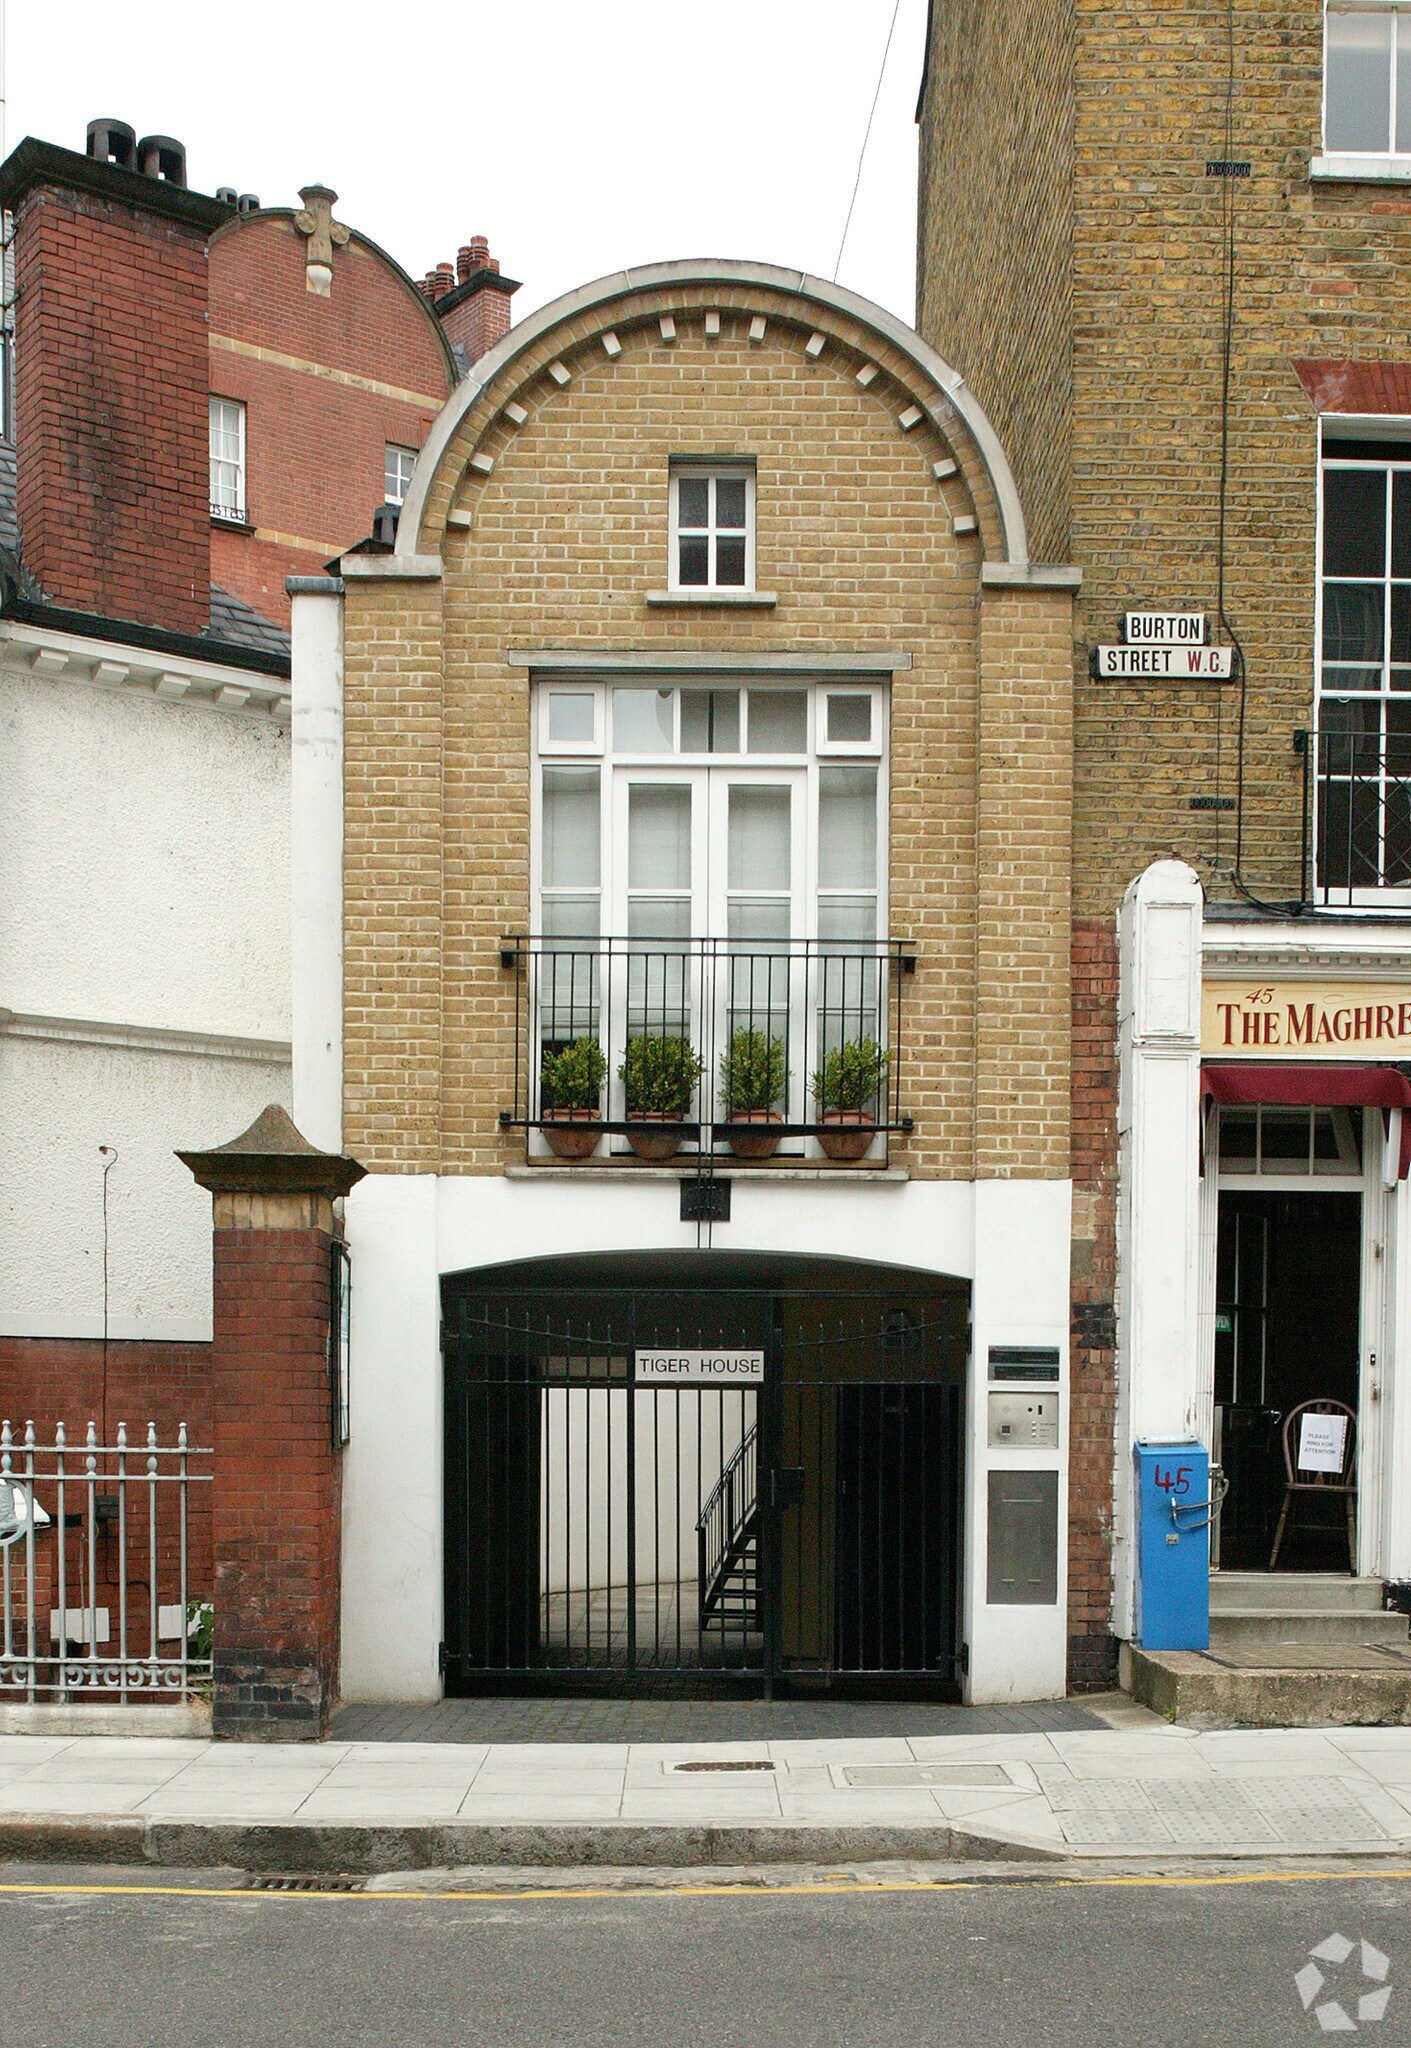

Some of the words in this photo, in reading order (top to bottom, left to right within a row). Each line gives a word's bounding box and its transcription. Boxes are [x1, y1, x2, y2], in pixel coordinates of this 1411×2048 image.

[1131, 617, 1200, 639] BURTON
[1107, 651, 1172, 672] STREET
[1187, 651, 1224, 673] W.C.
[1245, 988, 1276, 1005] 45
[1216, 1003, 1281, 1046] THE
[1284, 1003, 1411, 1046] MAGHRE
[639, 1358, 690, 1373] TIGER
[700, 1359, 760, 1373] HOUSE
[1155, 1464, 1194, 1494] 45
